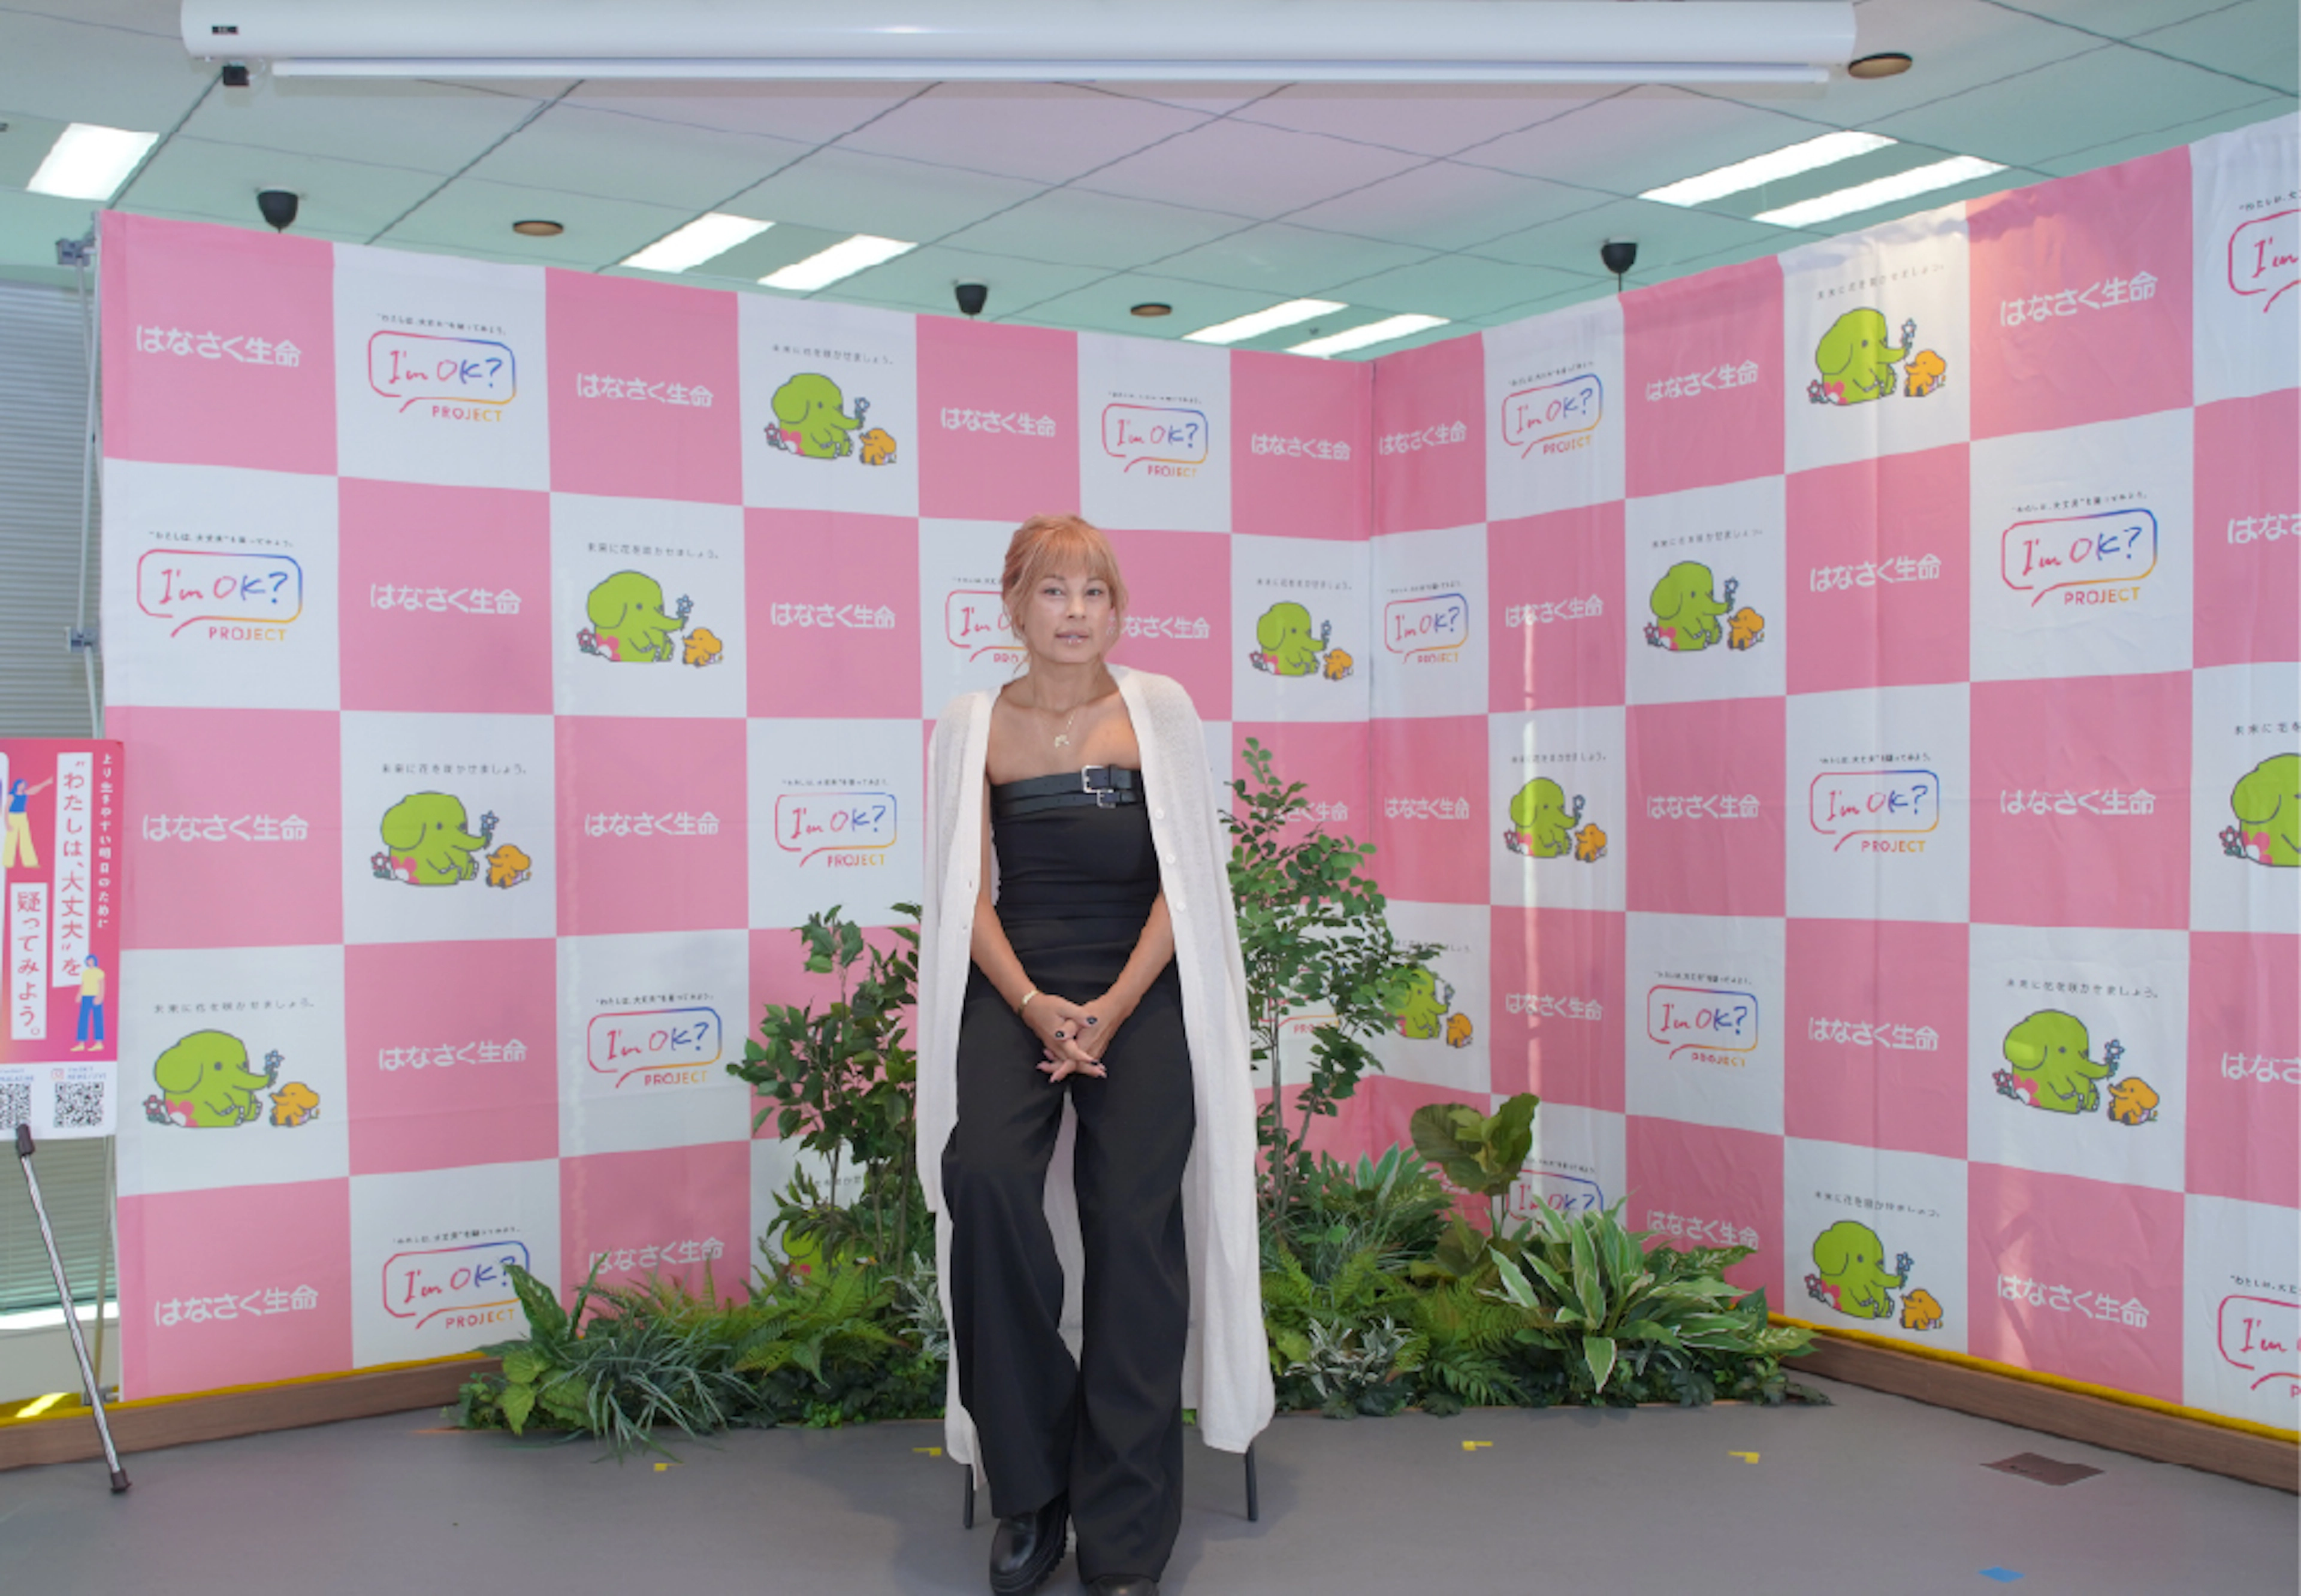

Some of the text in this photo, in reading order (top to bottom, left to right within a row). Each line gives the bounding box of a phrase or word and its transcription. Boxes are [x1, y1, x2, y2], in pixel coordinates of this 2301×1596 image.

[2252, 237, 2299, 277] I'm
[2000, 271, 2158, 327] はなさく生命
[135, 325, 301, 368] はなさく生命
[389, 350, 503, 388] I'm OK?
[1646, 361, 1759, 402] はなさく生命
[577, 373, 714, 408] はなさく生命
[1546, 388, 1593, 421] OK?
[433, 406, 501, 421] PROJECT
[941, 406, 1056, 438] はなさく生命
[1150, 423, 1198, 448] OK?
[1252, 434, 1352, 461] はなさく生命
[1380, 421, 1467, 455] はなさく生命
[1542, 436, 1592, 455] PROJECT
[1148, 466, 1195, 477] PROJECT
[2023, 527, 2142, 576] I'm OK?
[159, 569, 288, 604] I'm OK?
[1810, 554, 1941, 592] はなさく生命
[370, 584, 522, 615] はなさく生命
[1505, 594, 1604, 628] はなさく生命
[2065, 587, 2140, 604] PROJECT
[770, 602, 896, 630] はなさく生命
[209, 627, 285, 640] PROJECT
[1384, 796, 1470, 820] はなさく生命
[1646, 794, 1762, 819] はなさく生命
[1827, 785, 1928, 821] I'm OK?
[2000, 788, 2157, 817] はなさく生命
[142, 814, 309, 842] はなさく生命
[585, 812, 720, 837] はなさく生命
[791, 805, 886, 839] I'm OK?
[828, 854, 884, 867] PROJECT
[1862, 841, 1925, 852] PROJECT
[17, 891, 41, 1036] 疑ってみよう。
[1505, 993, 1604, 1021] はなさく生命
[1696, 1006, 1747, 1035] OK?
[608, 1022, 709, 1060] I'm OK?
[1808, 1017, 1940, 1051] はなさく生命
[379, 1038, 528, 1072] はなさく生命
[1692, 1053, 1745, 1066] PROJECT
[645, 1071, 706, 1086] PROJECT
[1647, 1209, 1759, 1252] はなさく生命
[590, 1237, 724, 1274] はなさく生命
[404, 1256, 515, 1303] I'm OK?
[154, 1283, 320, 1329] はなさく生命
[444, 1307, 514, 1328] PROJECT
[1997, 1273, 2151, 1330] はなさく生命
[2240, 1318, 2288, 1352] I'm
